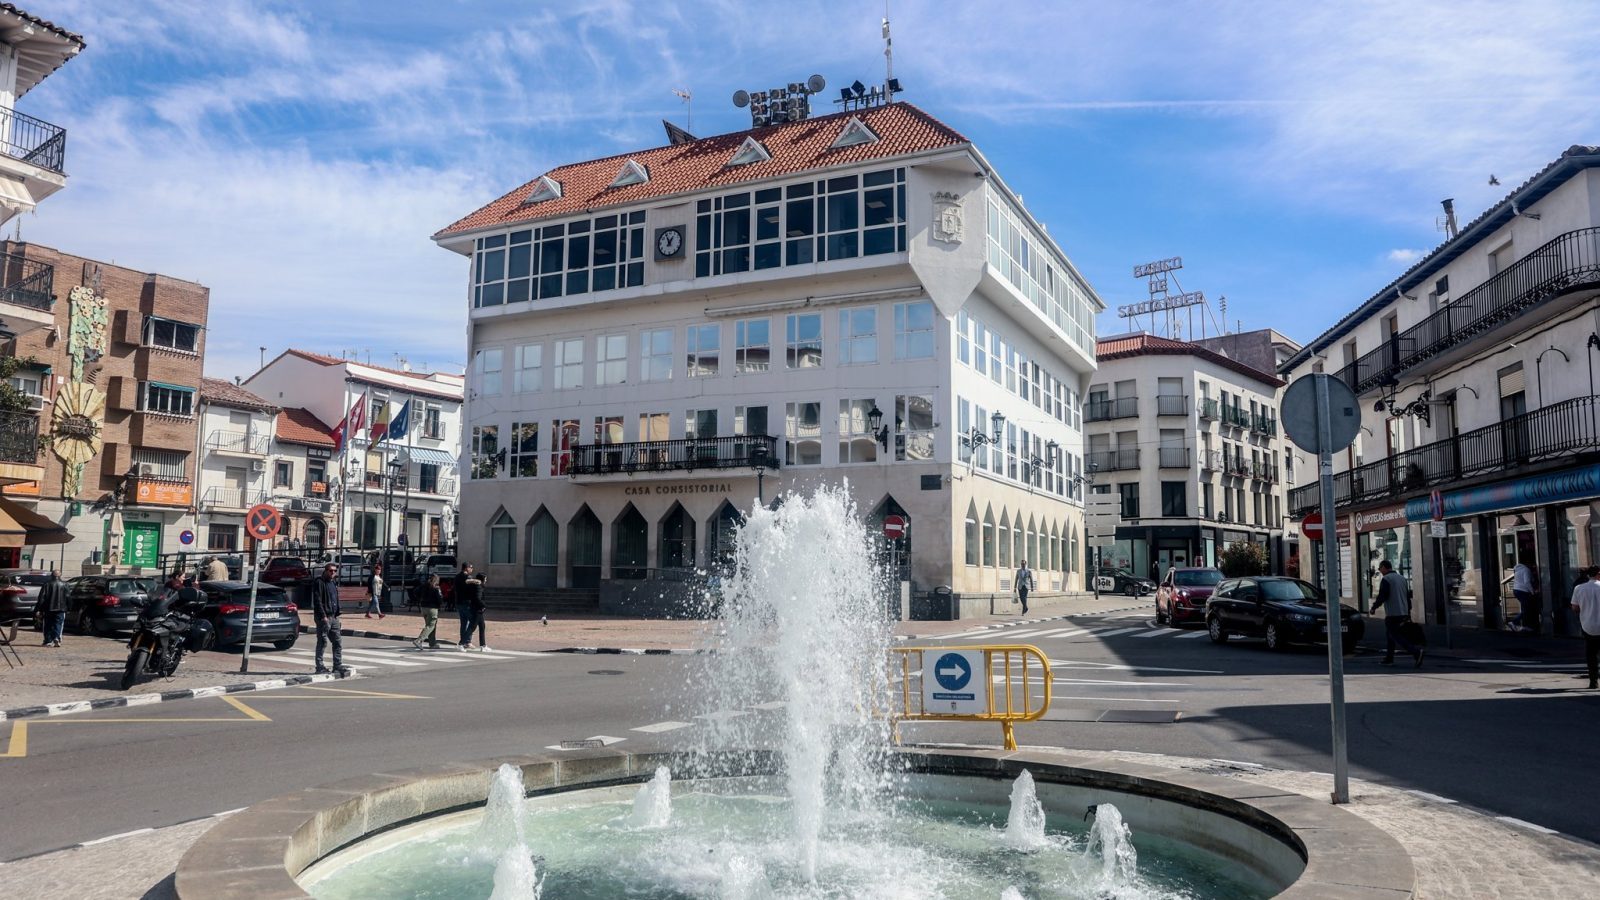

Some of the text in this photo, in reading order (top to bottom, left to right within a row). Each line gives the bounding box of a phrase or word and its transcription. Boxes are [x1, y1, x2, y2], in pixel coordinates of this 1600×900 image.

[1133, 256, 1183, 278] BANCO
[1148, 280, 1168, 293] DE
[1117, 290, 1204, 318] SANTANDER
[624, 483, 733, 495] CASA CONSISTORIAL
